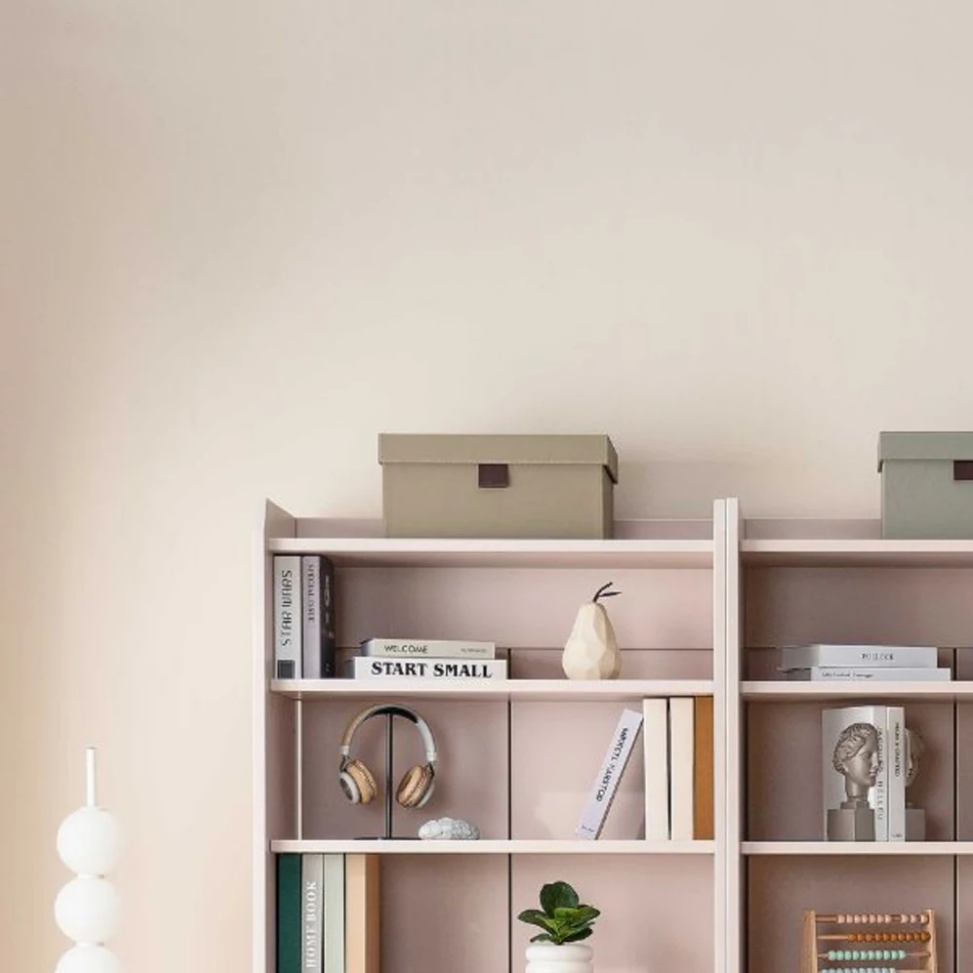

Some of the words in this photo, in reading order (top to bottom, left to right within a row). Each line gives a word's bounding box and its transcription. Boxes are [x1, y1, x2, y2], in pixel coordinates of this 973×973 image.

[281, 611, 292, 646] STAR
[384, 645, 428, 654] WELCOME
[371, 662, 428, 676] START
[433, 664, 492, 678] SMALL
[306, 881, 316, 921] BOOK
[306, 926, 316, 968] HOME
